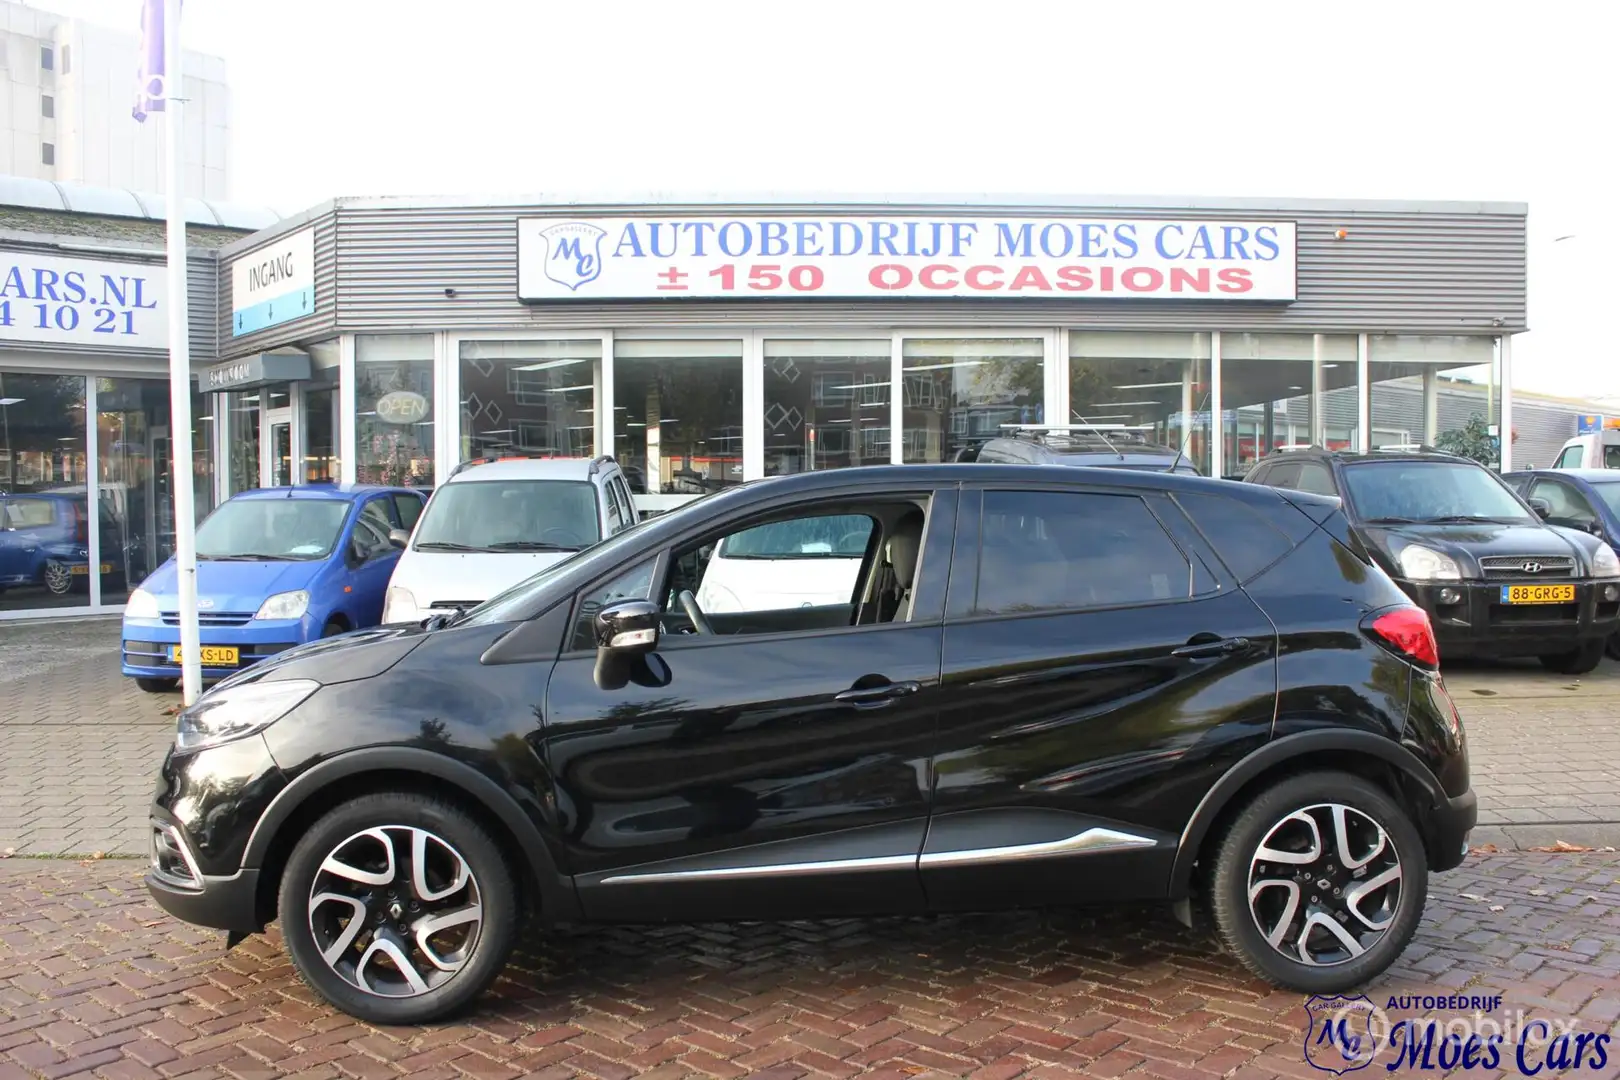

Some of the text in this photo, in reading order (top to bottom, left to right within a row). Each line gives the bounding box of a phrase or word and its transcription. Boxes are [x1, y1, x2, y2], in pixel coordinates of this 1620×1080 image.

[612, 221, 1280, 261] AUTOBEDRIJF MOES CARS
[0, 266, 158, 309] ARS.NL
[249, 251, 293, 292] INGANG
[656, 264, 1254, 293] ± 150 OCCASIONS
[33, 303, 80, 331] 10
[92, 308, 139, 335] 21
[376, 399, 427, 416] OPEN
[1512, 586, 1572, 600] 88-GRG-5
